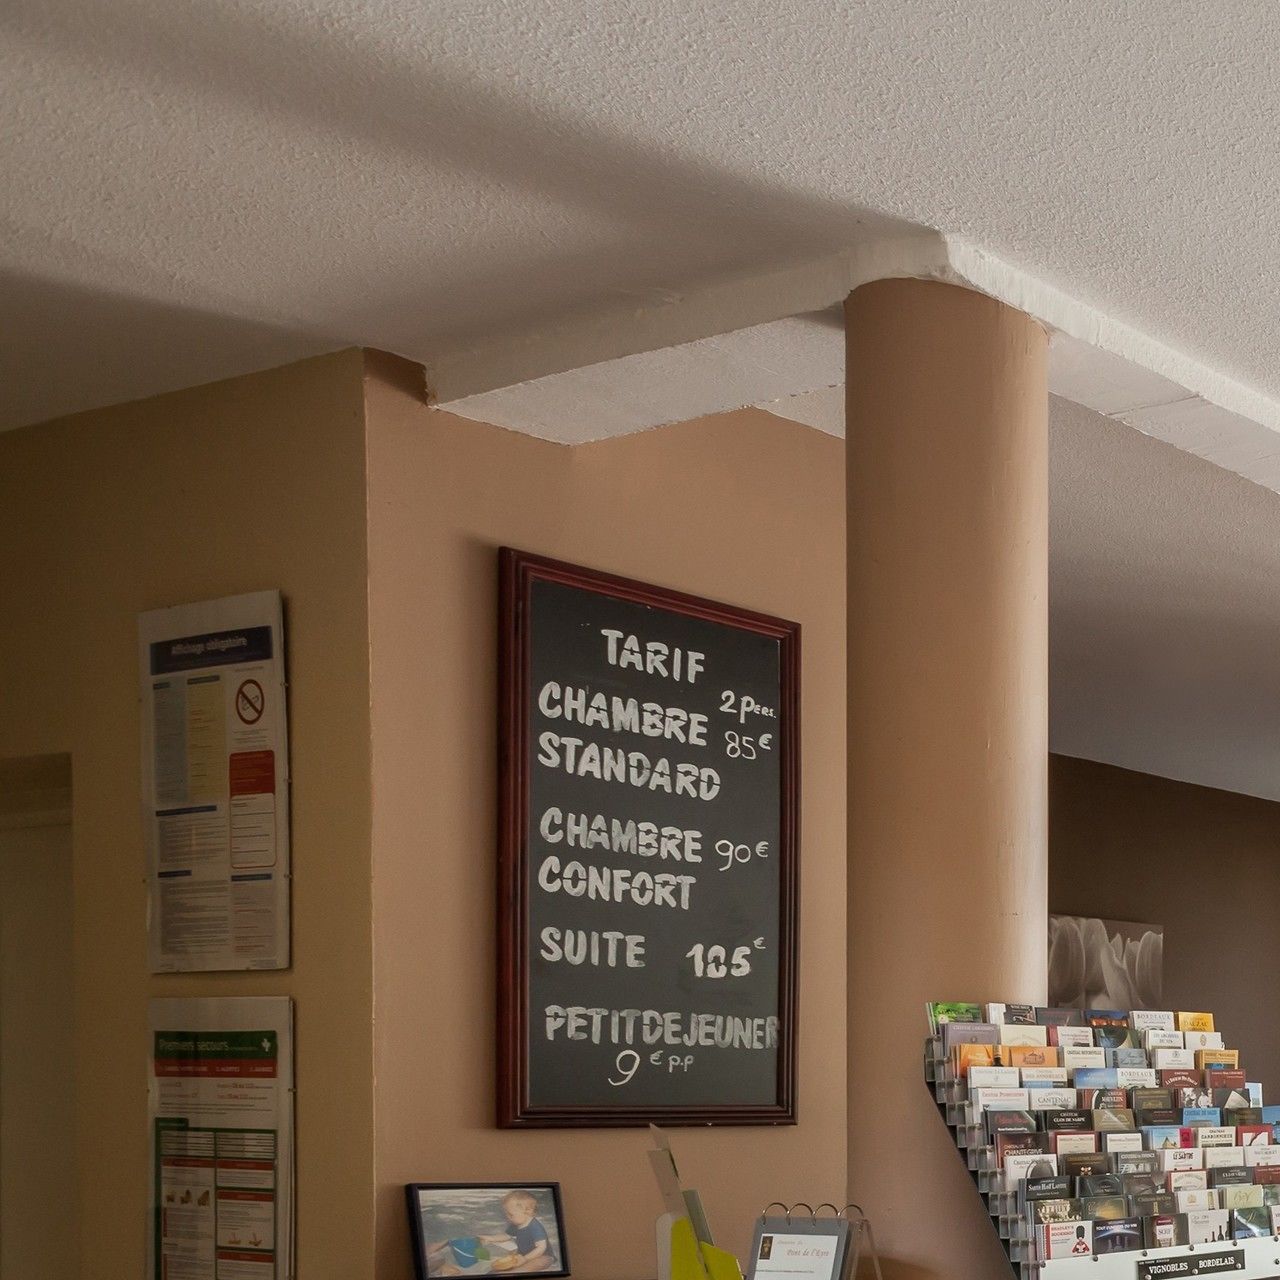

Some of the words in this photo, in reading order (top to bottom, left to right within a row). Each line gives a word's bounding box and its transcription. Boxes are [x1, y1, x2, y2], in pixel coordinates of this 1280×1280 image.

[600, 628, 706, 684] TARIF
[537, 680, 708, 747] CHAMBRE
[537, 732, 721, 802] STANDARD
[539, 806, 702, 864] CHAMBRE
[537, 855, 696, 910] CONFORT
[540, 926, 646, 968] SUITE
[1137, 1013, 1171, 1021] BORDEAUX
[1037, 1096, 1072, 1104] CANTENAC
[1148, 1262, 1189, 1274] VIGNOBLES
[1198, 1257, 1235, 1269] BORDELAIS
